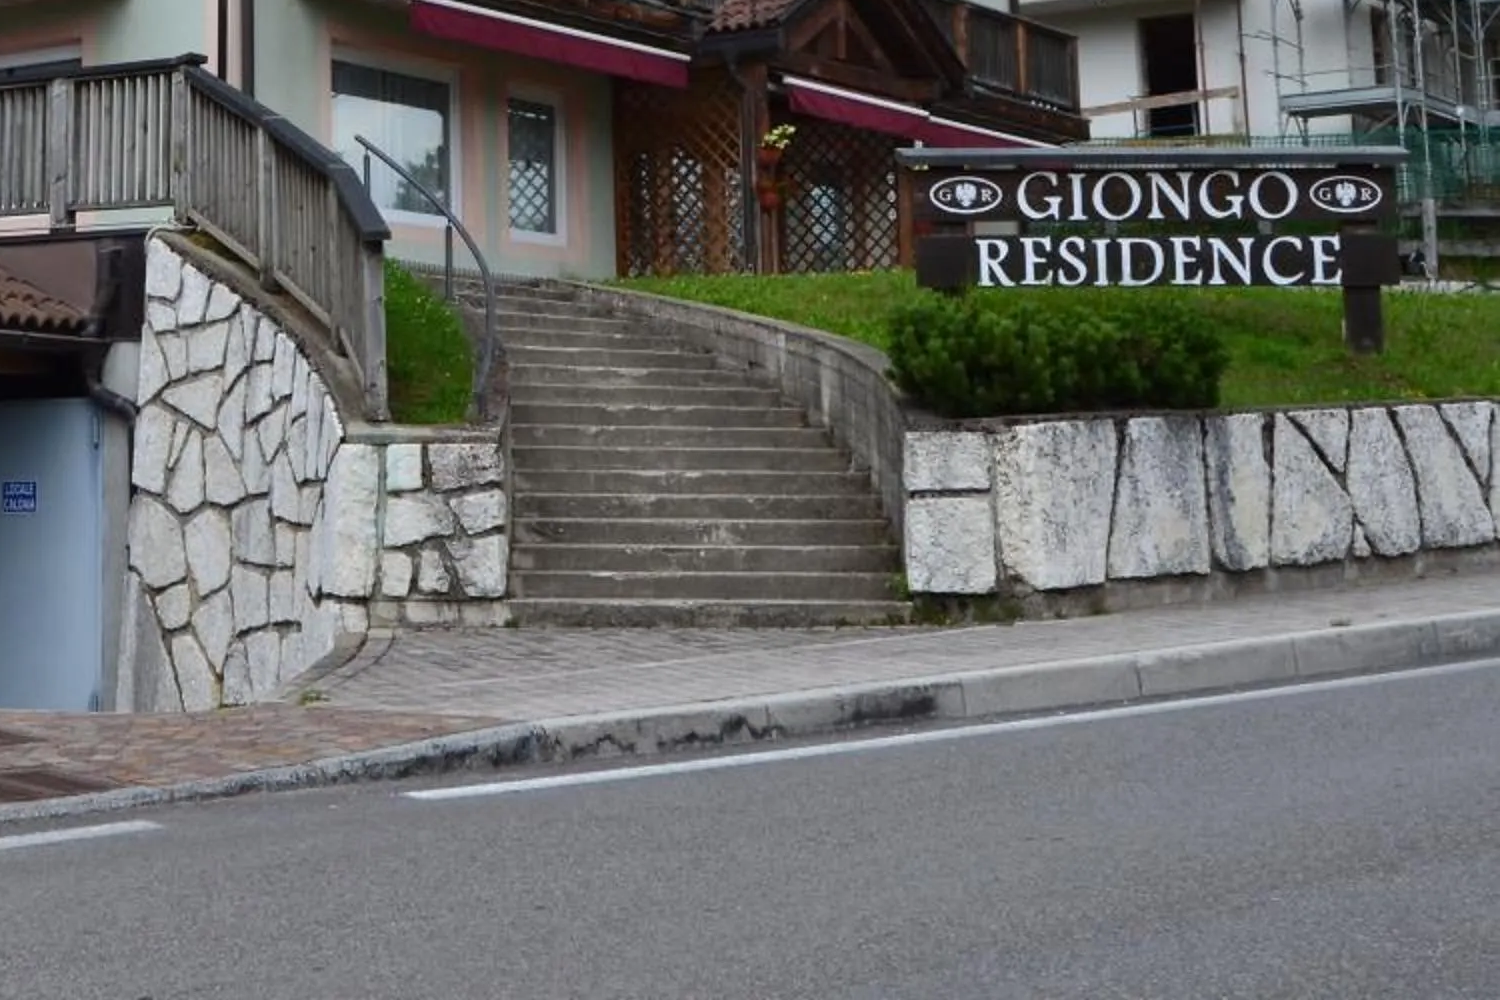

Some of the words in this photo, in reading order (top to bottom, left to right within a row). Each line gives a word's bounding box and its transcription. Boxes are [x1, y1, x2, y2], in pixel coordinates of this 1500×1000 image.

[939, 187, 952, 201] G
[981, 188, 993, 202] R
[1016, 171, 1299, 221] GIONGO
[1319, 187, 1331, 201] G
[1360, 187, 1372, 201] R
[975, 235, 1343, 287] RESIDENCE
